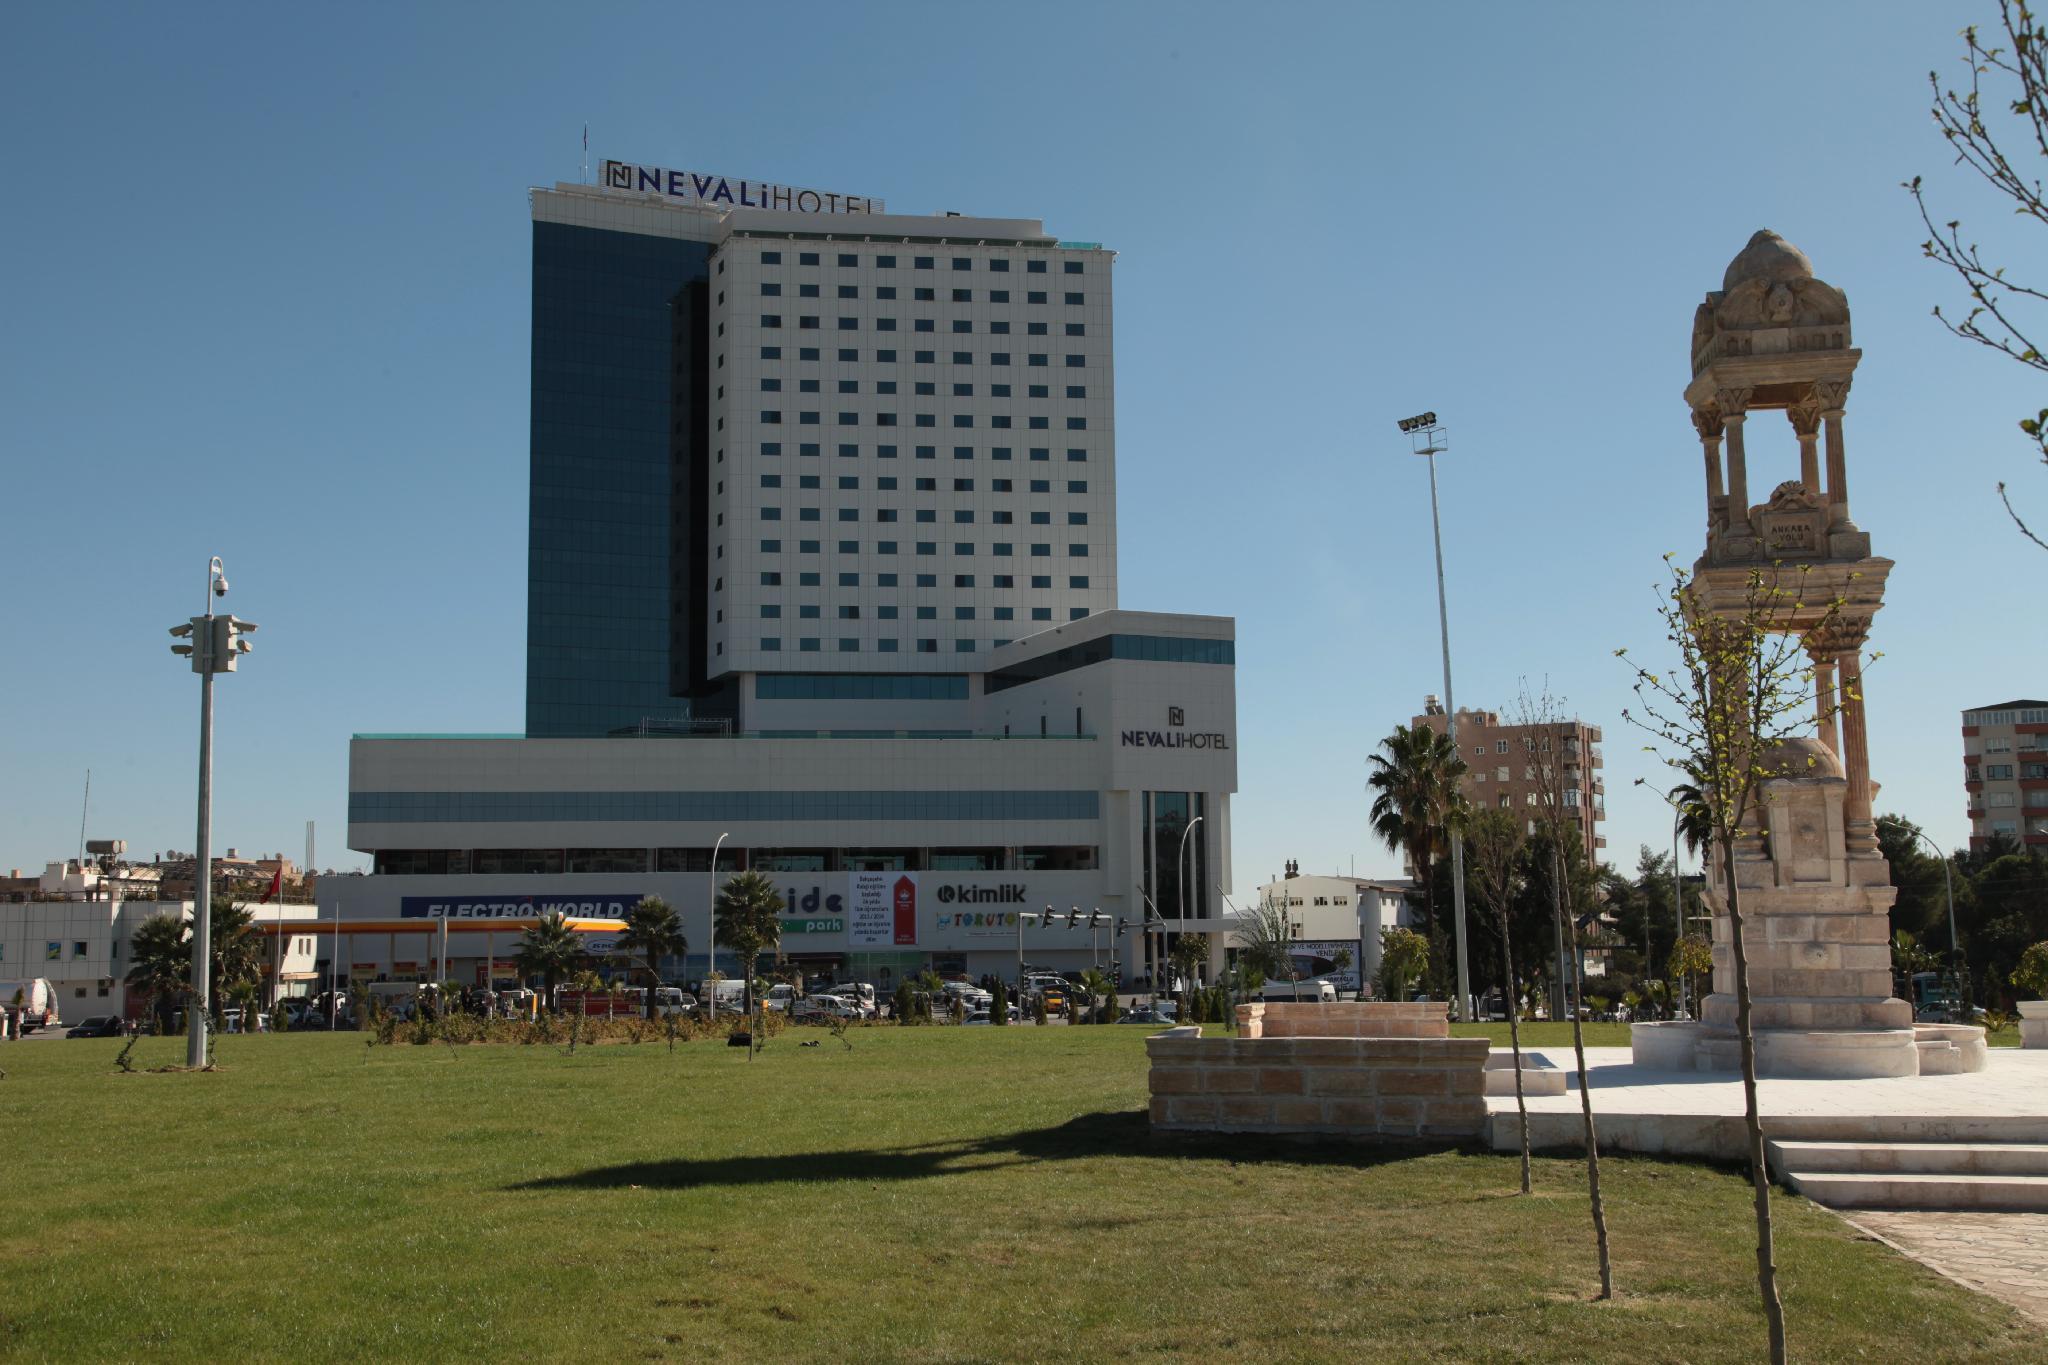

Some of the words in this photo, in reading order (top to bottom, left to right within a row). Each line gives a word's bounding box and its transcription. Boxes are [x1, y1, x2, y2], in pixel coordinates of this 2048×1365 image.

[1771, 525, 1810, 534] ANKARA
[957, 884, 1027, 903] kimlik
[427, 903, 534, 918] ELECTRO
[541, 902, 624, 918] WORLD
[806, 919, 841, 933] park
